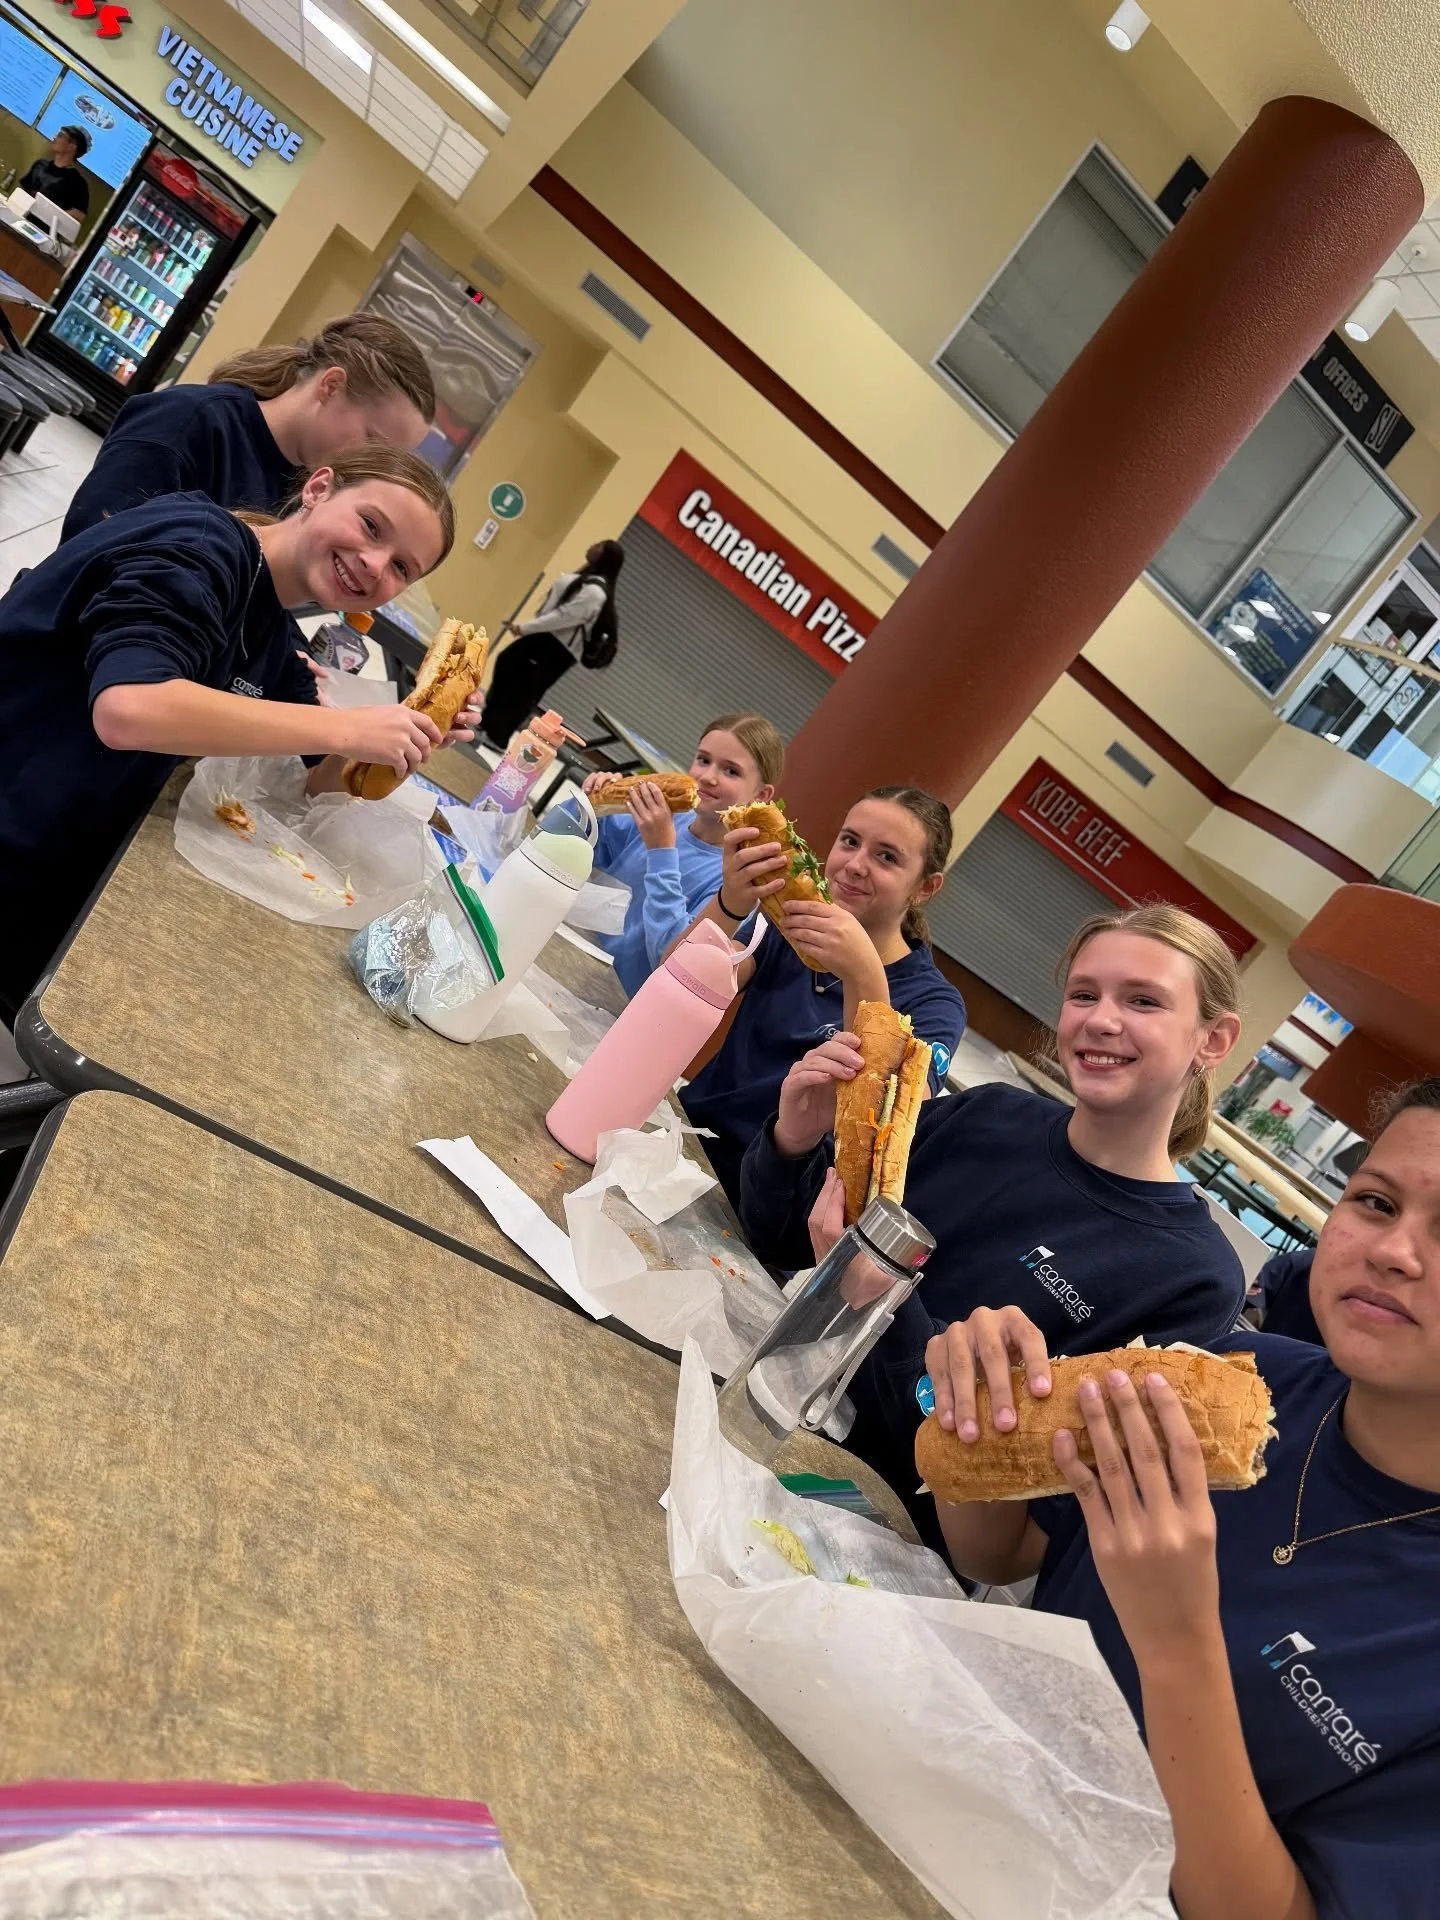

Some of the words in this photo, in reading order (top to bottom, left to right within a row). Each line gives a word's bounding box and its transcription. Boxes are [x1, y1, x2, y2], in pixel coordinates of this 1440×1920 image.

[157, 25, 304, 162] VIETNAMESE
[165, 77, 263, 168] CUISINE
[1322, 356, 1369, 413] OFFICES
[678, 489, 812, 618] Canadian
[805, 598, 867, 664] Pizz
[1026, 777, 1087, 835] KOBE
[1074, 817, 1130, 868] BEEF
[681, 974, 706, 995] owala
[1033, 1270, 1065, 1304] CHILDREN'S
[1064, 1303, 1082, 1324] CHOIR
[1039, 1264, 1094, 1319] cantaré
[1280, 1675, 1330, 1735] CHILDREN'S
[1328, 1735, 1364, 1774] CHOIR
[1290, 1664, 1383, 1765] cantaré
